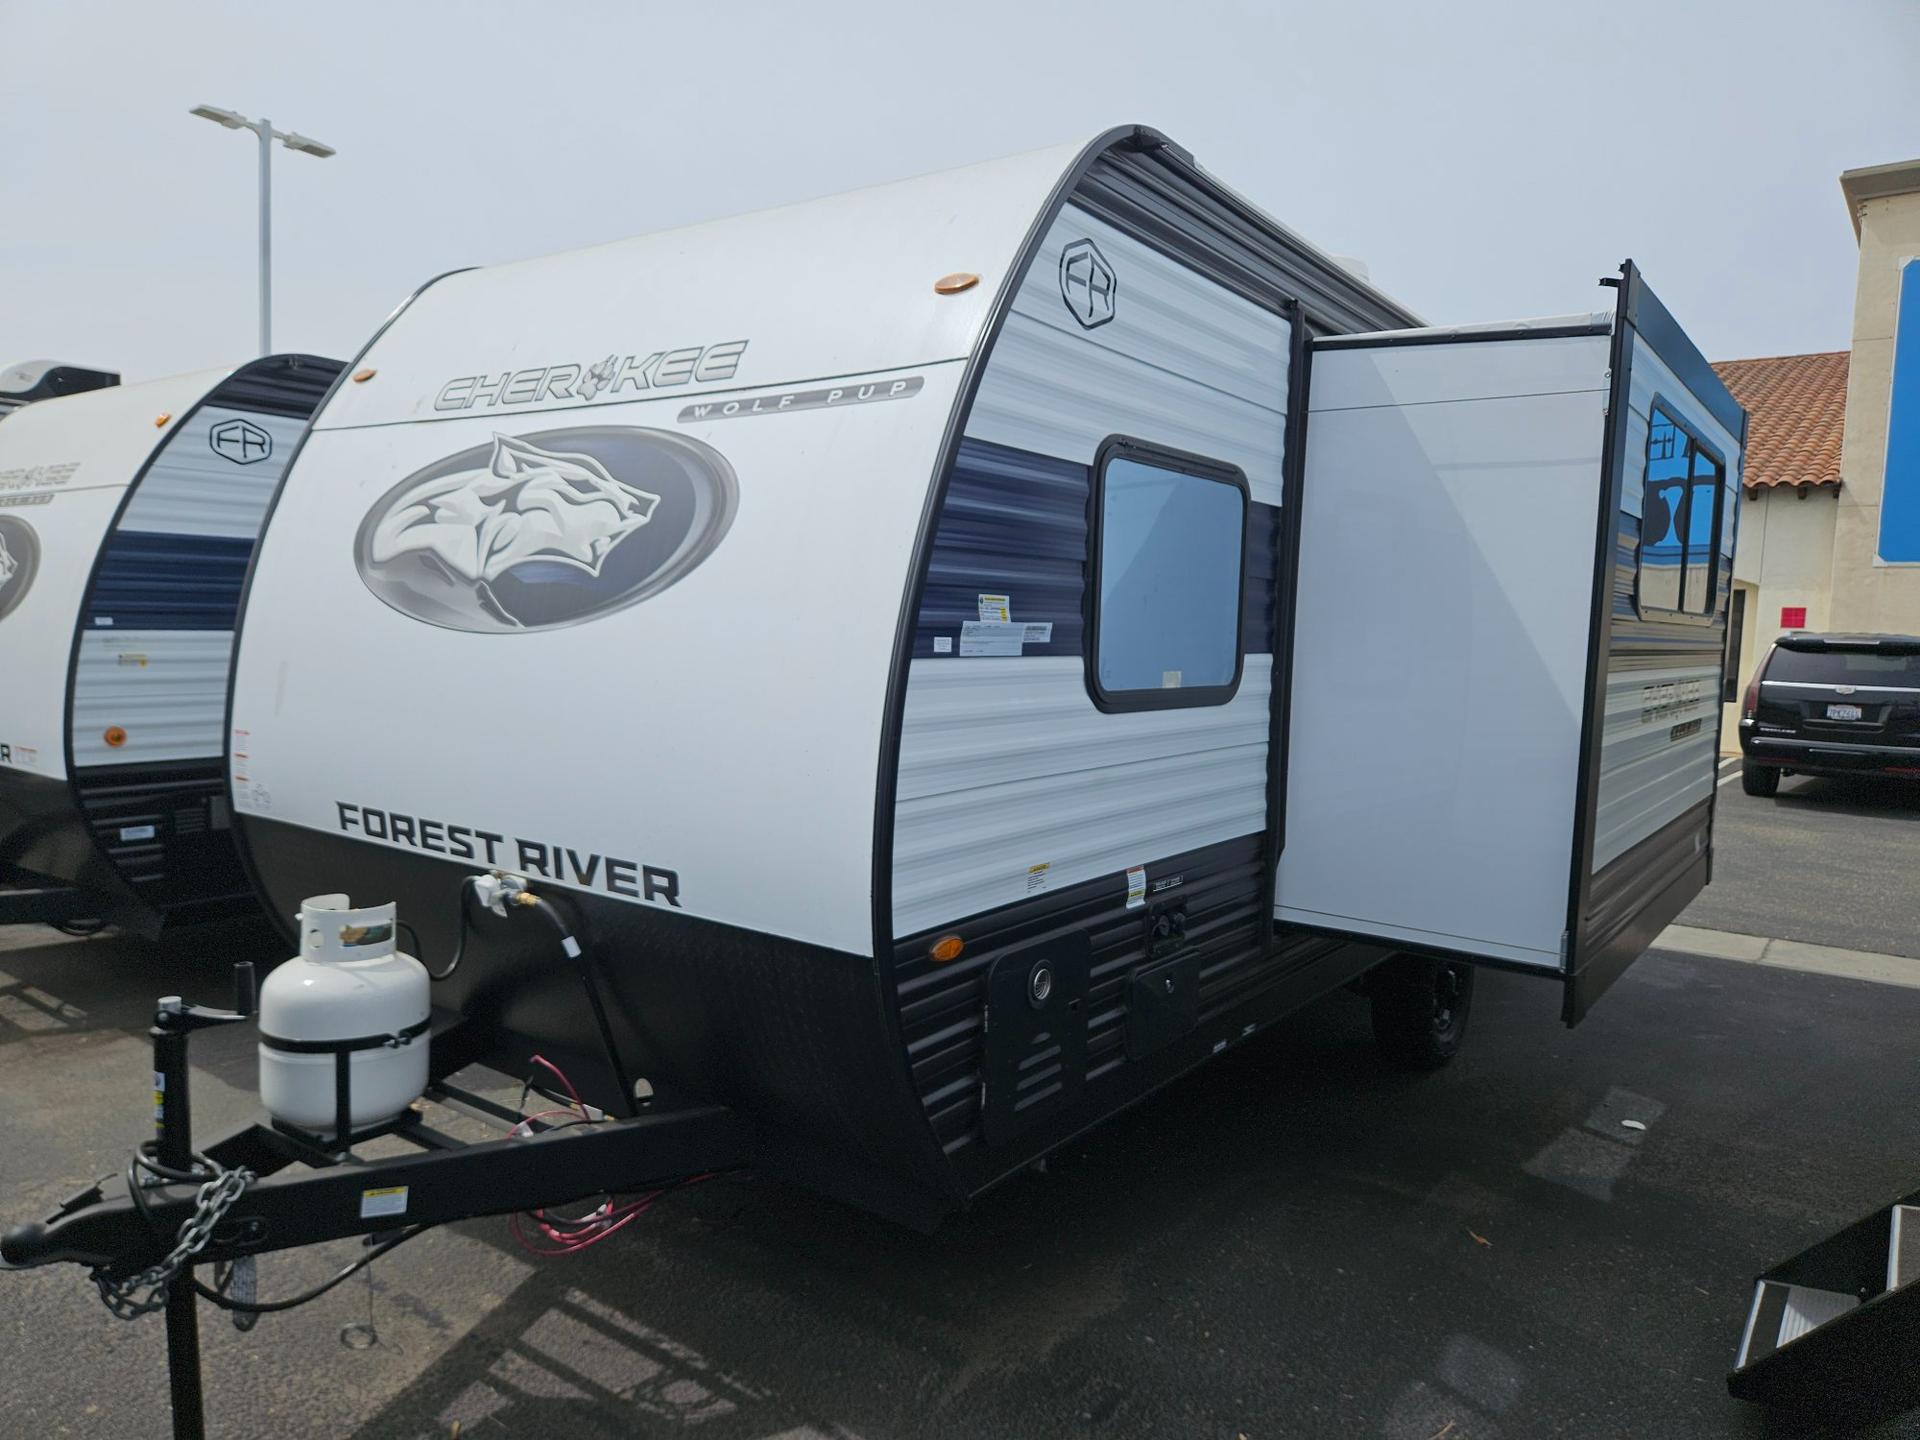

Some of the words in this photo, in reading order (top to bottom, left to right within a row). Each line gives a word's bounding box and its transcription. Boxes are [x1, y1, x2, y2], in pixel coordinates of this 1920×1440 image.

[693, 395, 795, 417] WOLF
[827, 381, 907, 403] PUP
[335, 800, 504, 864] FOREST
[514, 837, 682, 907] RIVER
